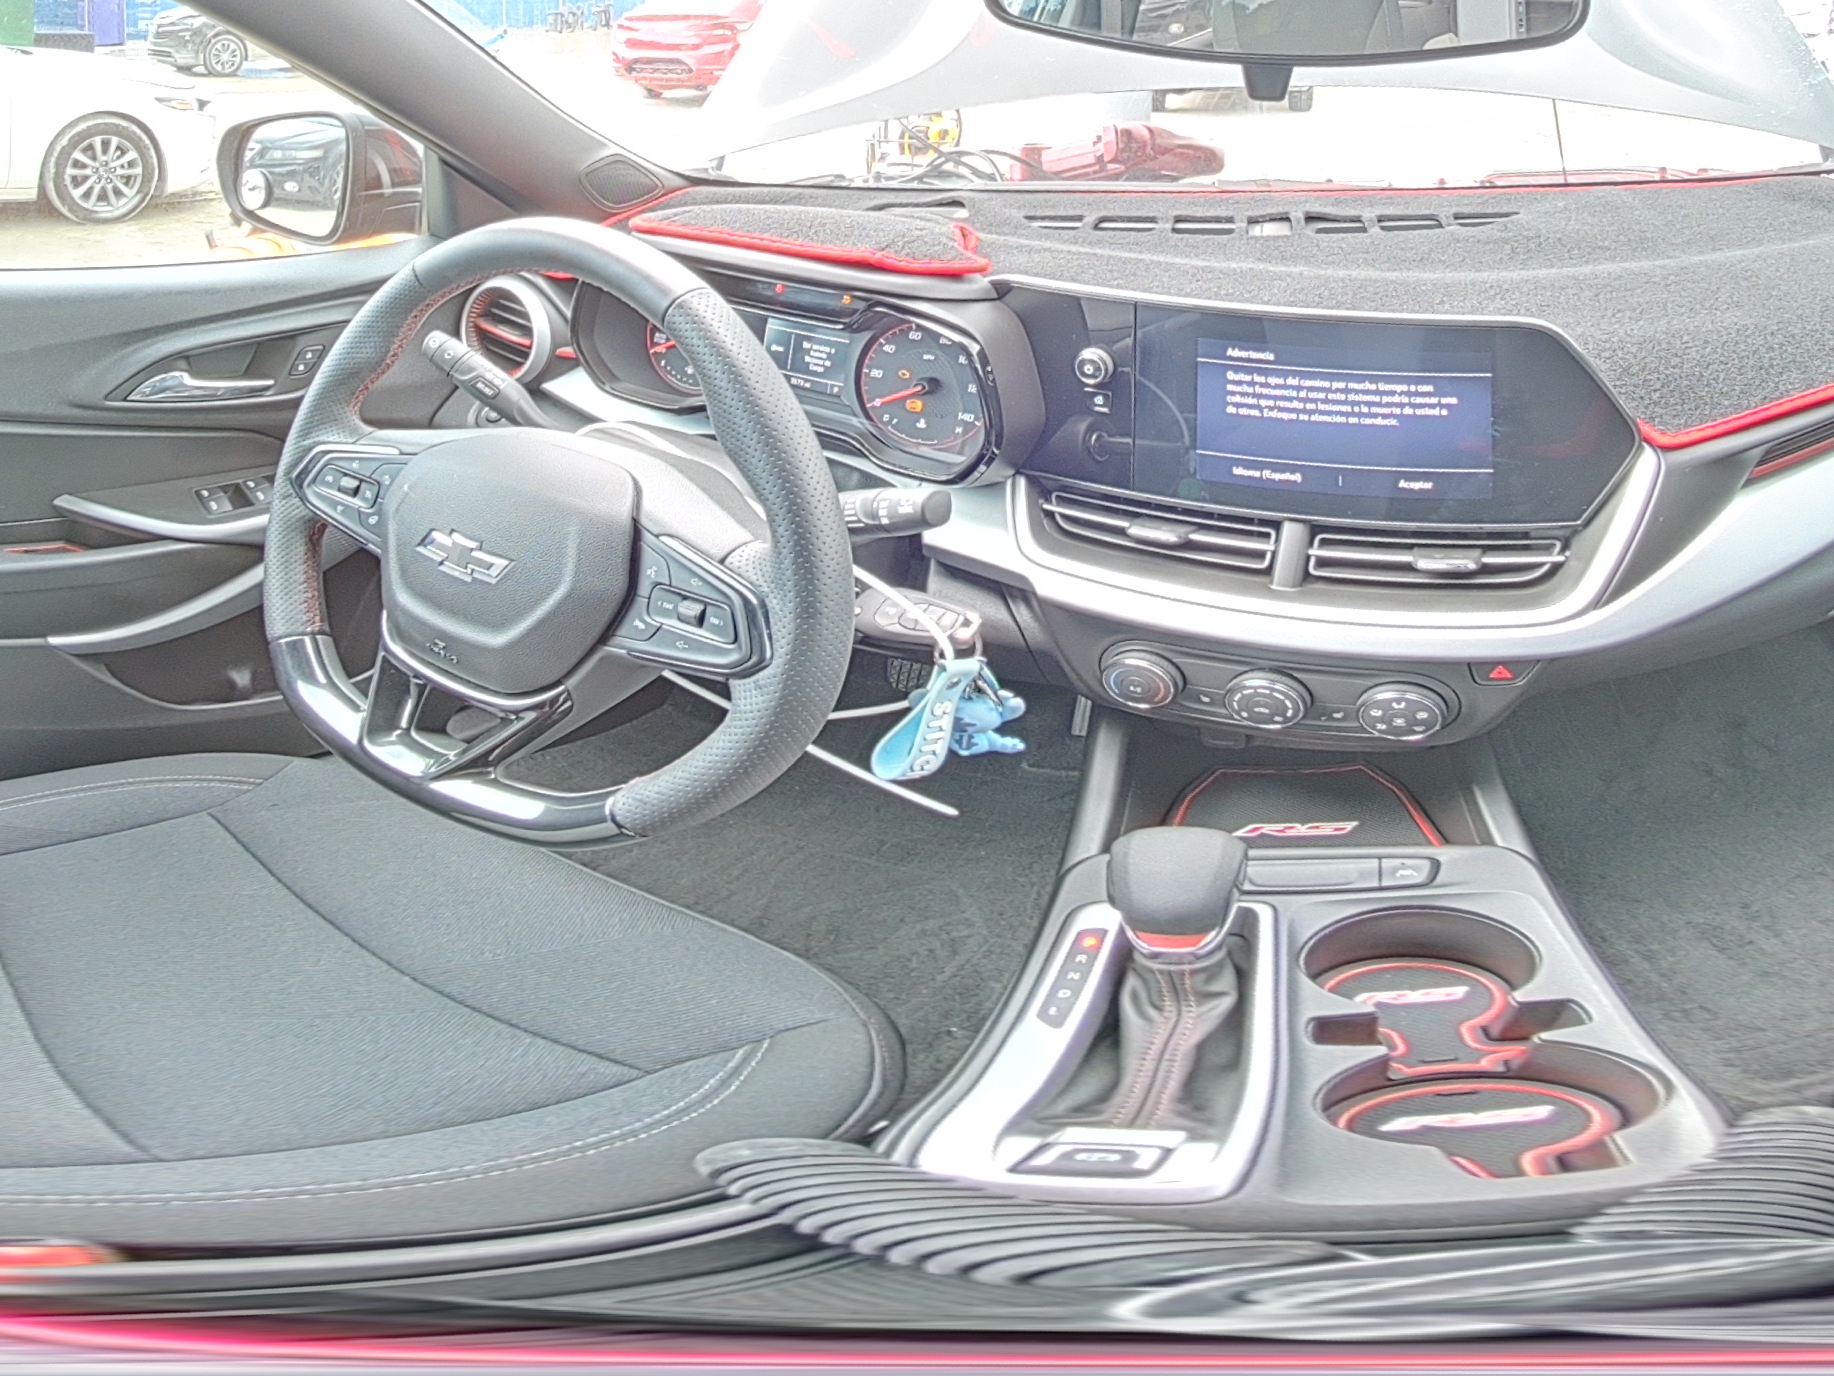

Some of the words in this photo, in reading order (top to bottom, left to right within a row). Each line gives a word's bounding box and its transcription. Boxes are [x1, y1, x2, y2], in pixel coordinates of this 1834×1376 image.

[909, 332, 922, 340] 60
[883, 344, 896, 353] 40
[1227, 347, 1275, 361] Advertencia
[870, 369, 883, 378] 20
[1227, 371, 1252, 383] Quitar
[1253, 372, 1265, 384] los
[1267, 375, 1284, 387] ojos
[1286, 376, 1299, 386] del
[1300, 378, 1330, 388] camino
[1332, 381, 1346, 390] por
[1348, 381, 1377, 391] mucho
[1378, 382, 1408, 394] tiempo
[1417, 385, 1434, 393] con
[1226, 383, 1253, 394] mucha
[1255, 385, 1297, 398] frecuencia
[1299, 388, 1306, 399] al
[1308, 391, 1326, 400] usar
[1328, 391, 1345, 401] este
[1347, 392, 1380, 402] sistema
[1382, 393, 1409, 405] podría
[1410, 396, 1439, 404] causar
[1226, 395, 1258, 406] colisión
[1259, 398, 1274, 408] que
[1276, 398, 1304, 409] resulte
[1306, 403, 1316, 411] en
[1317, 402, 1351, 413] lesiones
[1361, 405, 1368, 414] la
[1370, 406, 1401, 415] muerte
[1402, 406, 1413, 415] de
[1415, 407, 1439, 416] usted
[958, 412, 975, 421] 140
[1226, 405, 1237, 415] de
[1238, 407, 1262, 417] otros.
[1263, 408, 1297, 421] Enfoque
[1299, 412, 1309, 421] su
[1310, 411, 1346, 423] atención
[1348, 415, 1358, 424] en
[1360, 415, 1400, 426] conducir.
[1232, 466, 1260, 478] Idioma
[1263, 468, 1302, 483] (Español)
[1398, 479, 1433, 490] Aceptar
[906, 700, 953, 779] STITC
[1232, 821, 1359, 836] RS
[1075, 954, 1088, 963] R
[1067, 971, 1080, 980] N
[1057, 989, 1072, 998] D
[1354, 985, 1470, 1004] RS
